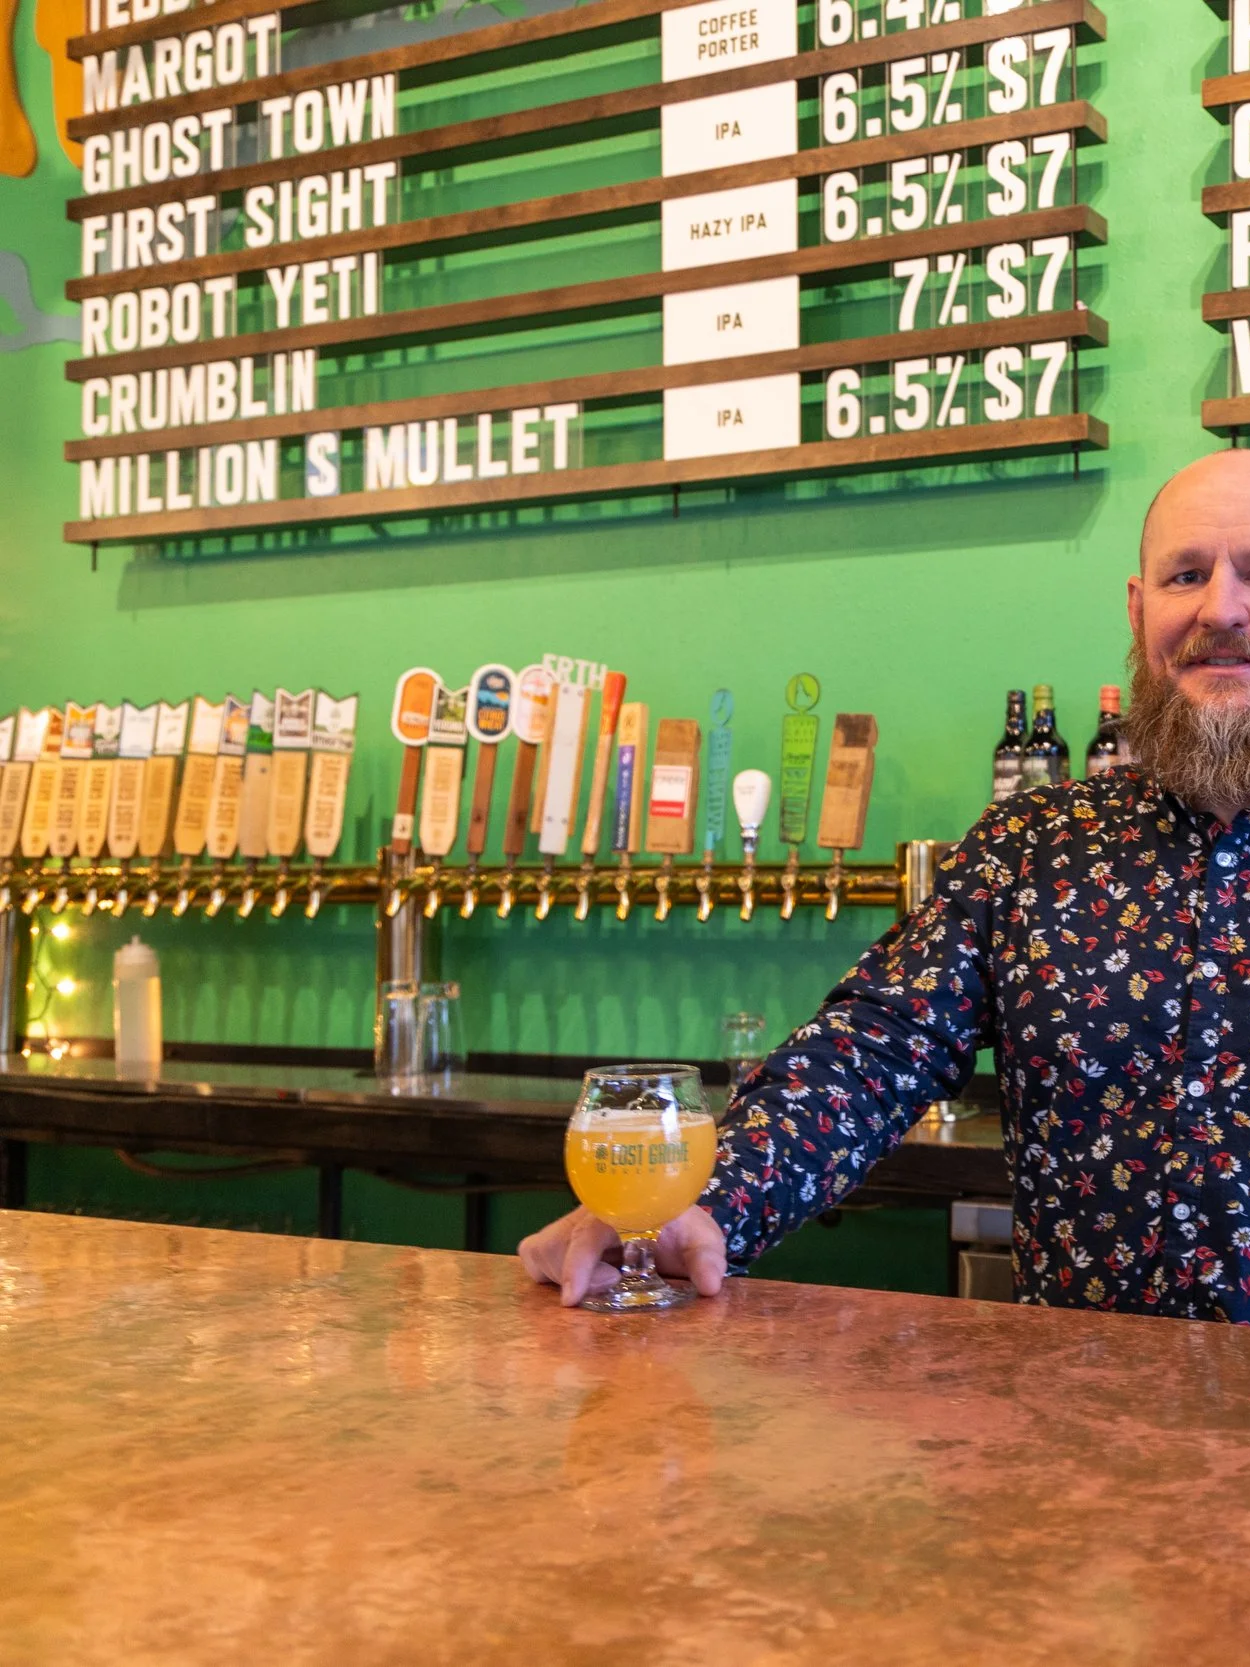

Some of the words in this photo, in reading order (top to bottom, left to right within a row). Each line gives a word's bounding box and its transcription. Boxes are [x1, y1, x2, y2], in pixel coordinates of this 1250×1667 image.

[83, 13, 278, 115] MARGOT
[698, 8, 758, 37] COFFEE
[698, 32, 760, 60] PORTER
[83, 108, 233, 195] GHOST
[262, 73, 397, 158] TOWN
[714, 121, 742, 141] IPA
[822, 50, 963, 145] 6.5%
[986, 27, 1072, 115] $7
[83, 196, 217, 276] FIRST
[245, 161, 397, 249] SIGHT
[690, 217, 734, 240] HAZY
[740, 212, 768, 233] IPA
[822, 152, 963, 243] 6.5%
[986, 131, 1072, 217] $7
[82, 276, 234, 357] ROBOT
[267, 251, 379, 329] YETI
[716, 312, 744, 332] IPA
[893, 252, 968, 331] 7%
[986, 236, 1071, 318] $7
[82, 348, 317, 437] CRUMBLIN
[716, 408, 744, 427] IPA
[826, 355, 966, 439] 6.5%
[983, 341, 1069, 422] $7
[80, 440, 277, 518] MILLION
[307, 431, 340, 498] S
[367, 402, 578, 490] MULLET
